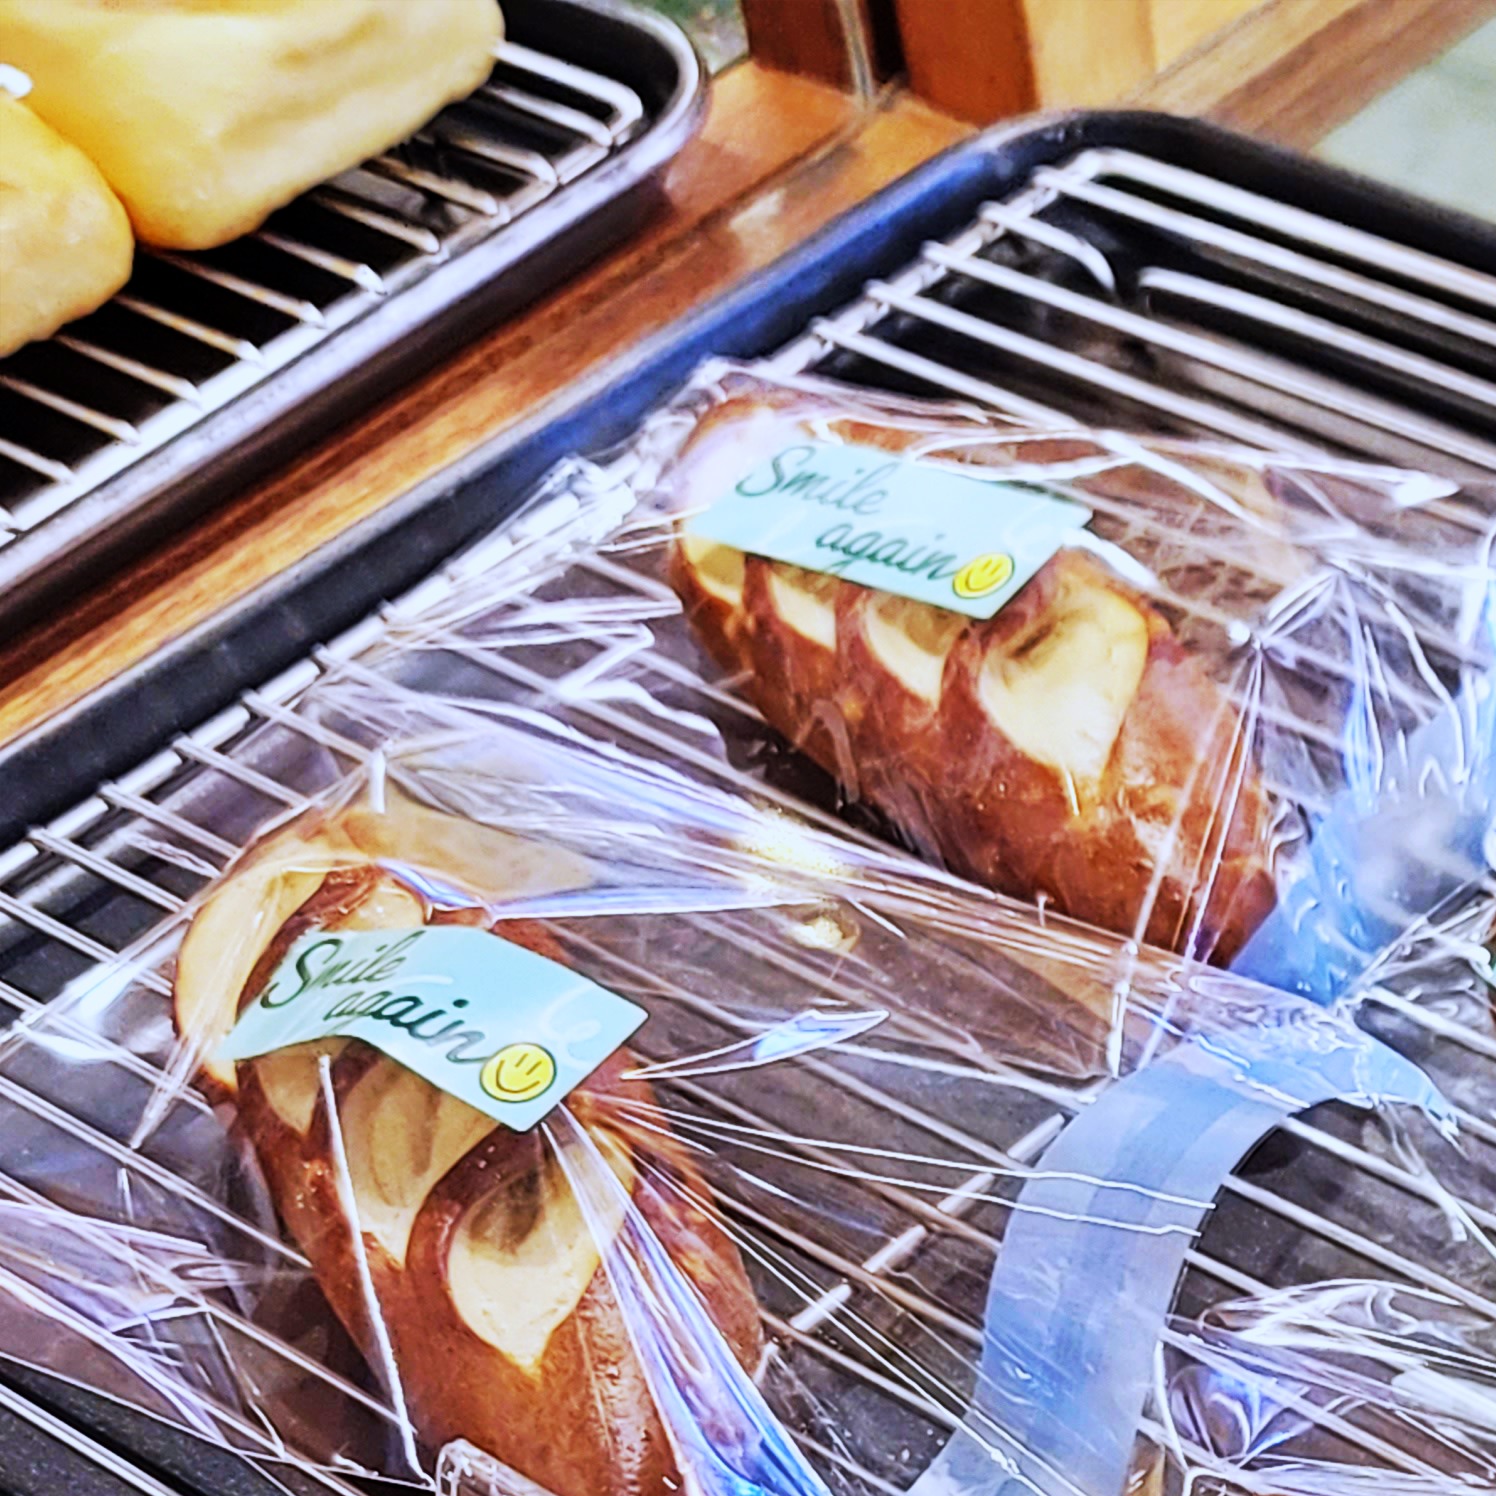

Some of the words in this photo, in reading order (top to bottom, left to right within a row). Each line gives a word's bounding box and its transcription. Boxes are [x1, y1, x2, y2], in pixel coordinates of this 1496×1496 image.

[736, 446, 897, 516] Smile
[815, 522, 958, 581] again
[262, 931, 426, 1008] Smile
[323, 988, 499, 1064] again
